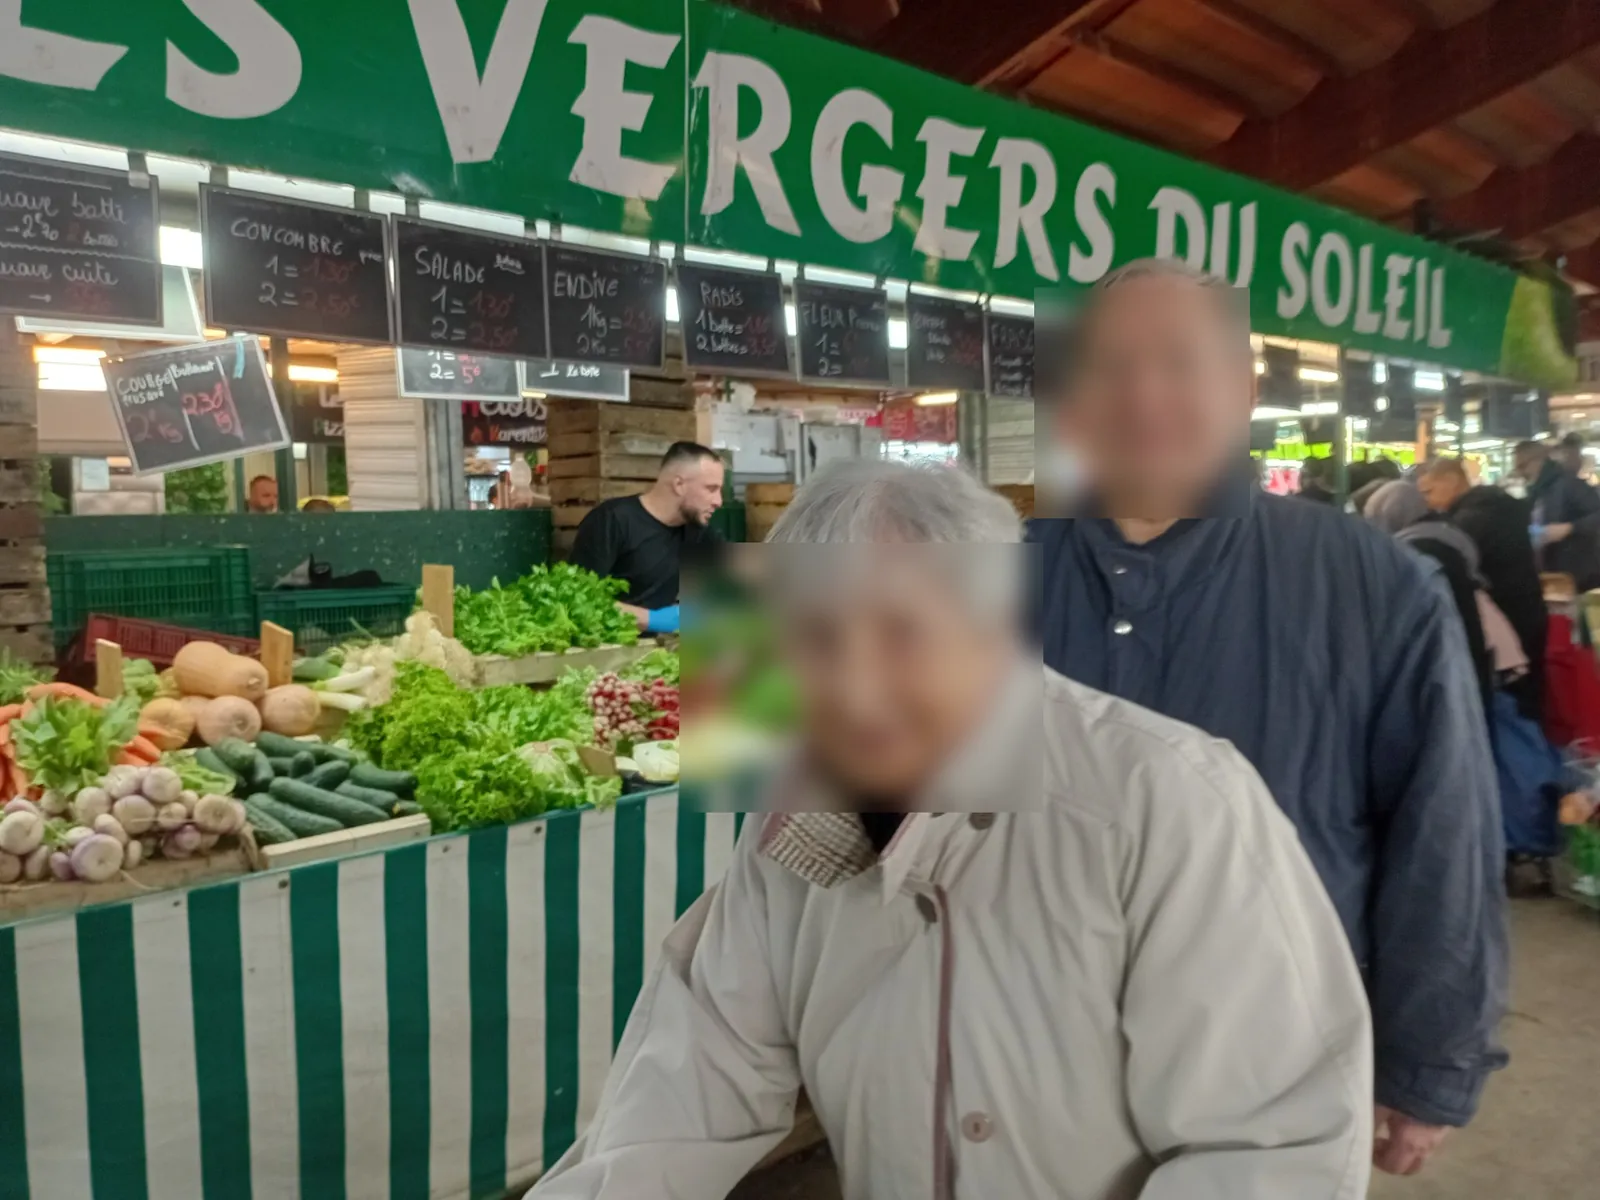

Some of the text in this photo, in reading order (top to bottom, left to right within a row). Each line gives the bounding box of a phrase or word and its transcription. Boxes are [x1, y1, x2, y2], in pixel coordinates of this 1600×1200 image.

[408, 0, 1118, 285] VERGERS
[1147, 186, 1258, 288] DU
[1277, 222, 1452, 350] SOLEIL
[230, 217, 344, 256] CONCOMBRE
[414, 245, 486, 284] SALADE
[116, 371, 171, 396] COURGE
